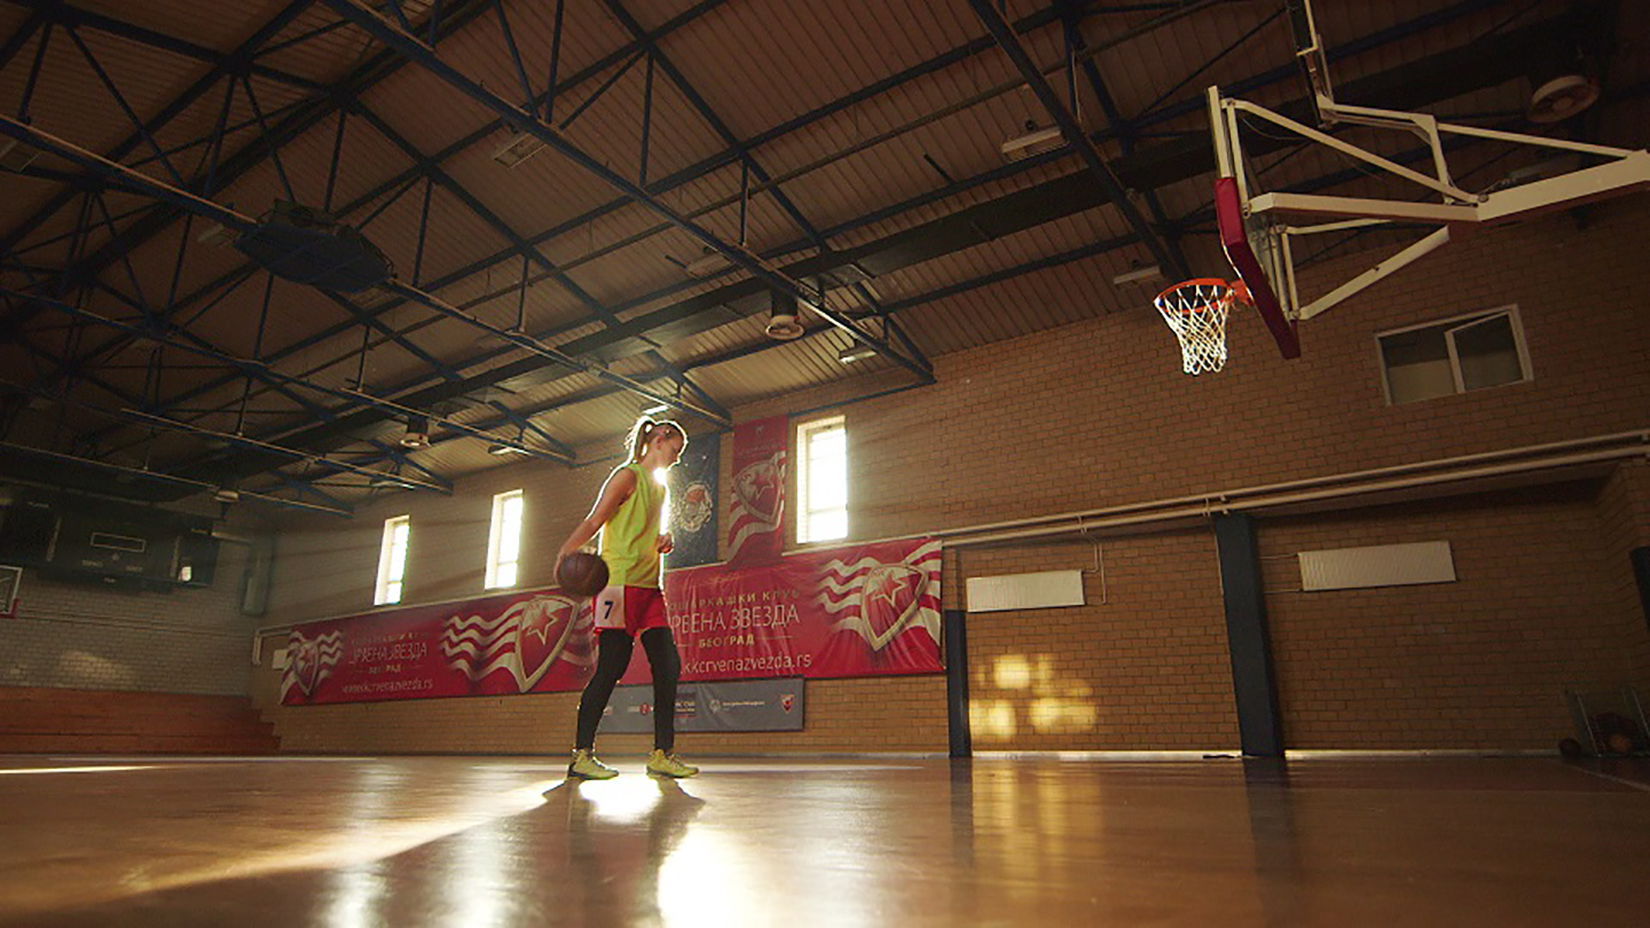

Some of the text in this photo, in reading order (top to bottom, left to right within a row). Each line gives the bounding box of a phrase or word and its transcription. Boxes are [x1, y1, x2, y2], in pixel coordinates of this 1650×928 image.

[604, 600, 614, 619] 7
[668, 592, 757, 611] ОШАРКАШКИ
[670, 604, 800, 634] РВЕНА ЗВЕЗДА
[698, 634, 755, 649] БЕОГРАД
